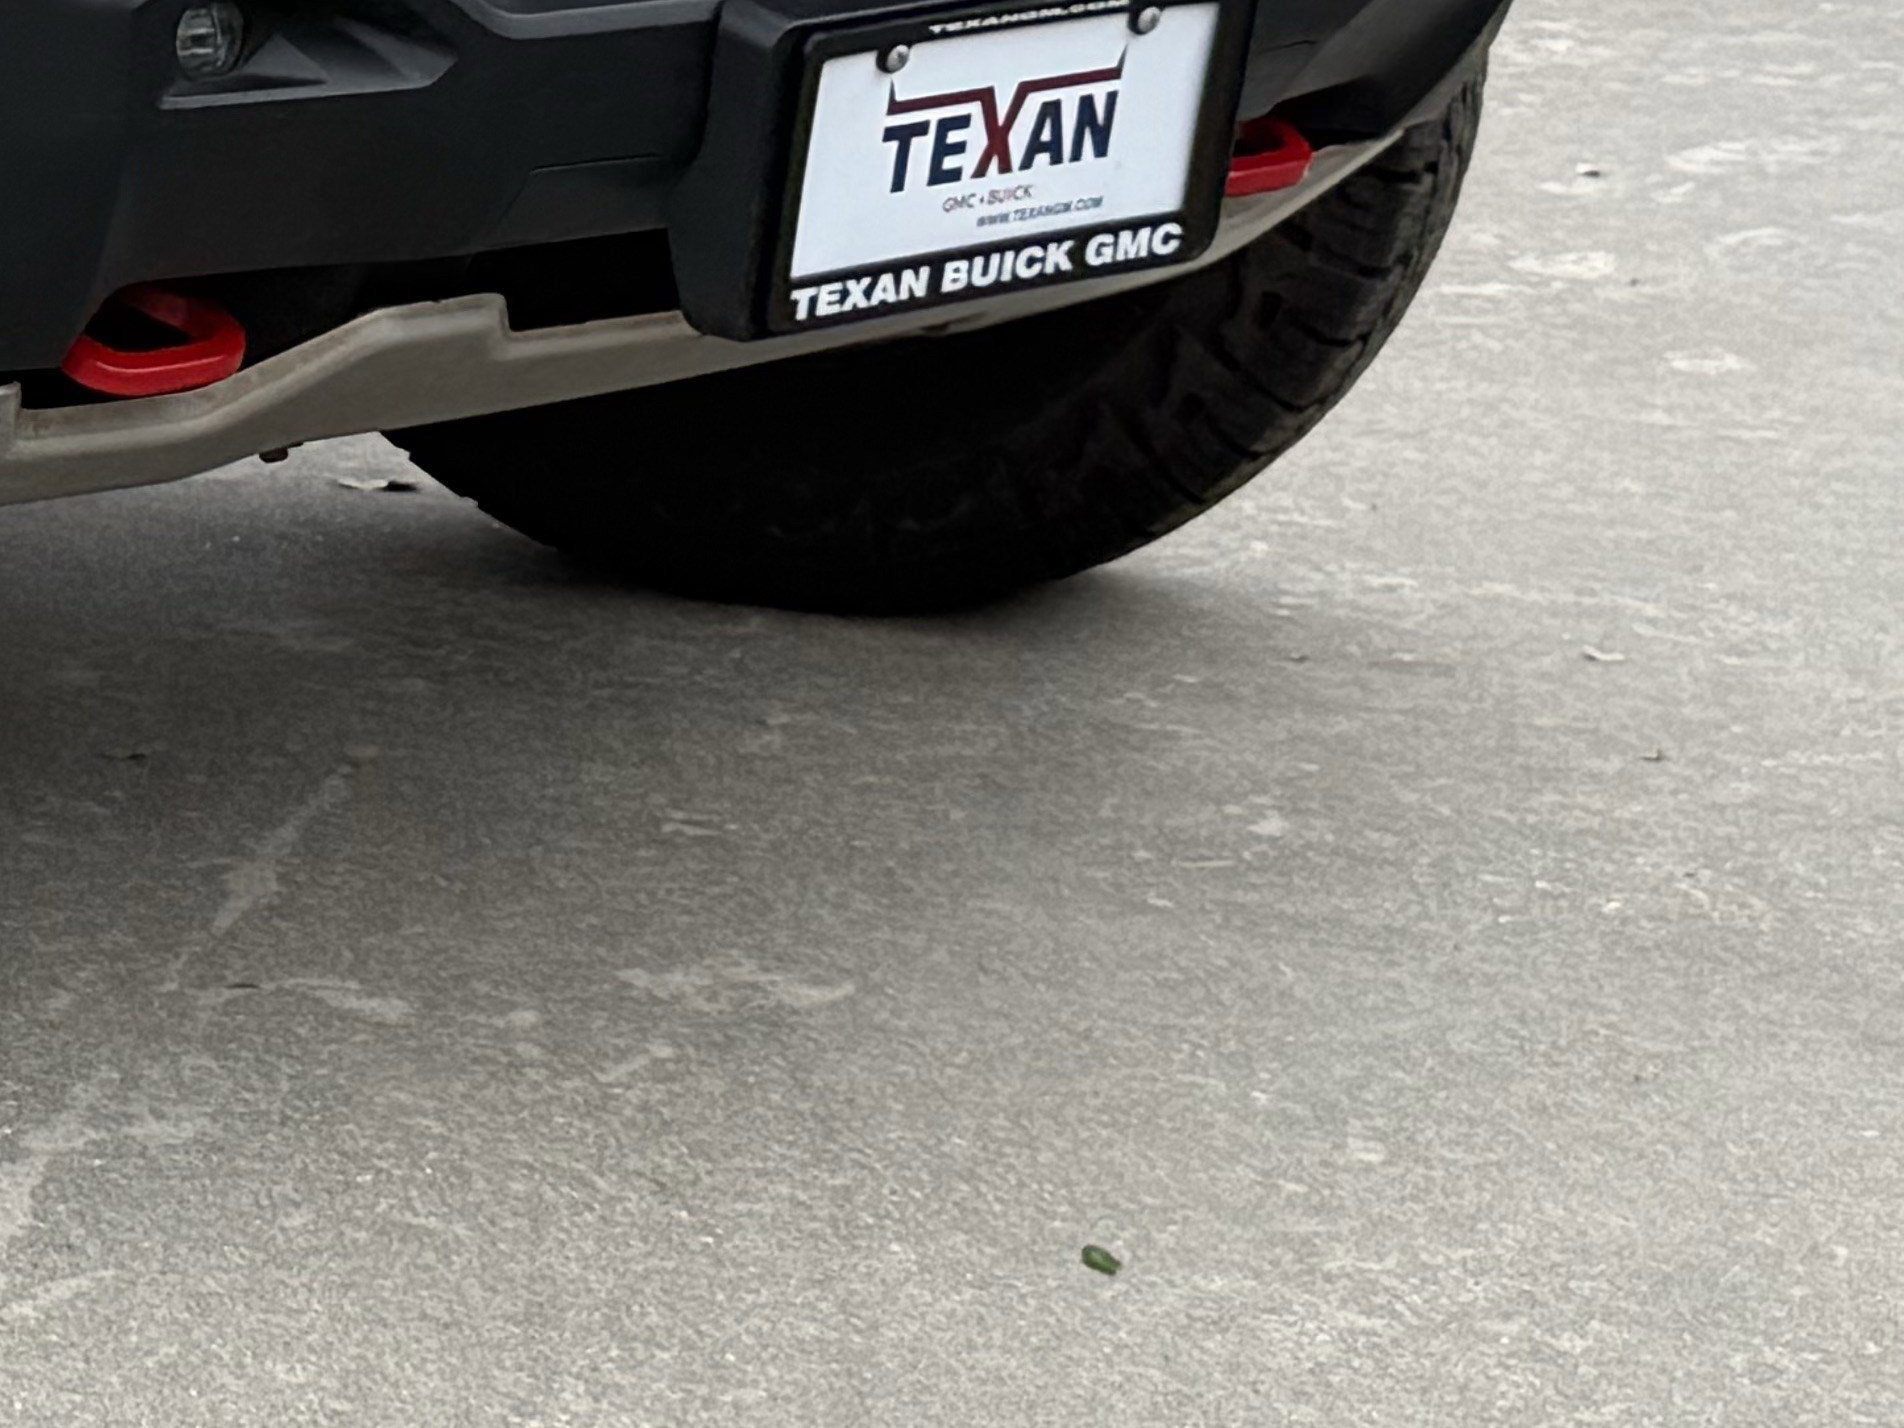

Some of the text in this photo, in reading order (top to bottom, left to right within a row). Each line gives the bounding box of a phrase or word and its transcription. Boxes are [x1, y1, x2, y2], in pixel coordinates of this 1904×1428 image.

[882, 46, 1127, 193] TEXAN
[790, 221, 1184, 321] TEXAN BUICK GMC
